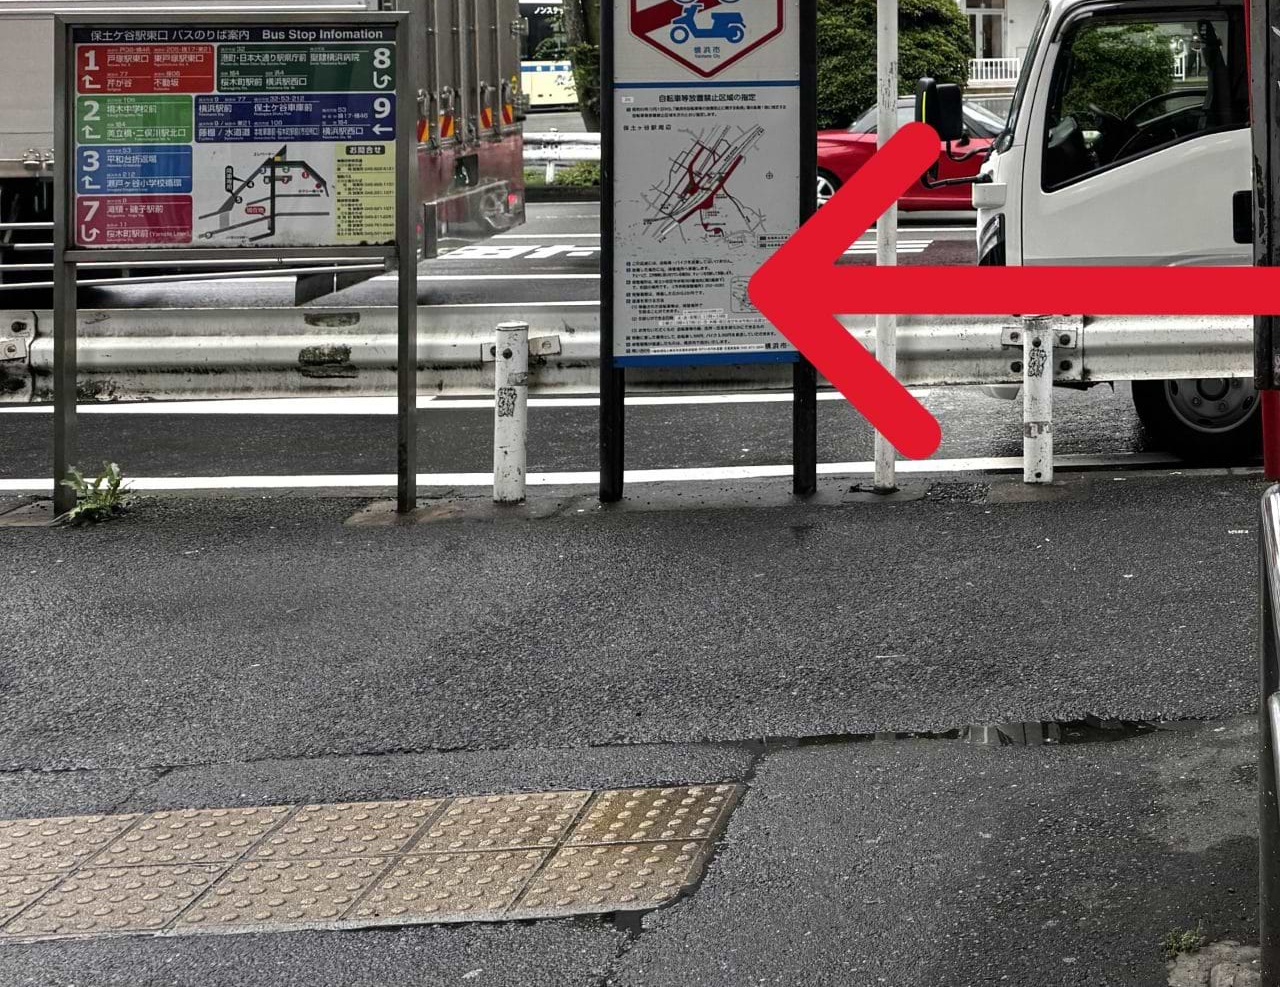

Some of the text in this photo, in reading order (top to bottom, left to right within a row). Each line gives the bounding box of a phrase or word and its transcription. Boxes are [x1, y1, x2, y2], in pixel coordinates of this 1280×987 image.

[172, 30, 250, 41] バスのりば案内
[262, 29, 383, 41] Bus Stop Infomation
[84, 50, 99, 70] 1
[373, 48, 391, 69] 8
[83, 100, 101, 121] 2
[373, 98, 391, 119] 9
[82, 150, 100, 171] 3
[82, 201, 100, 222] 7
